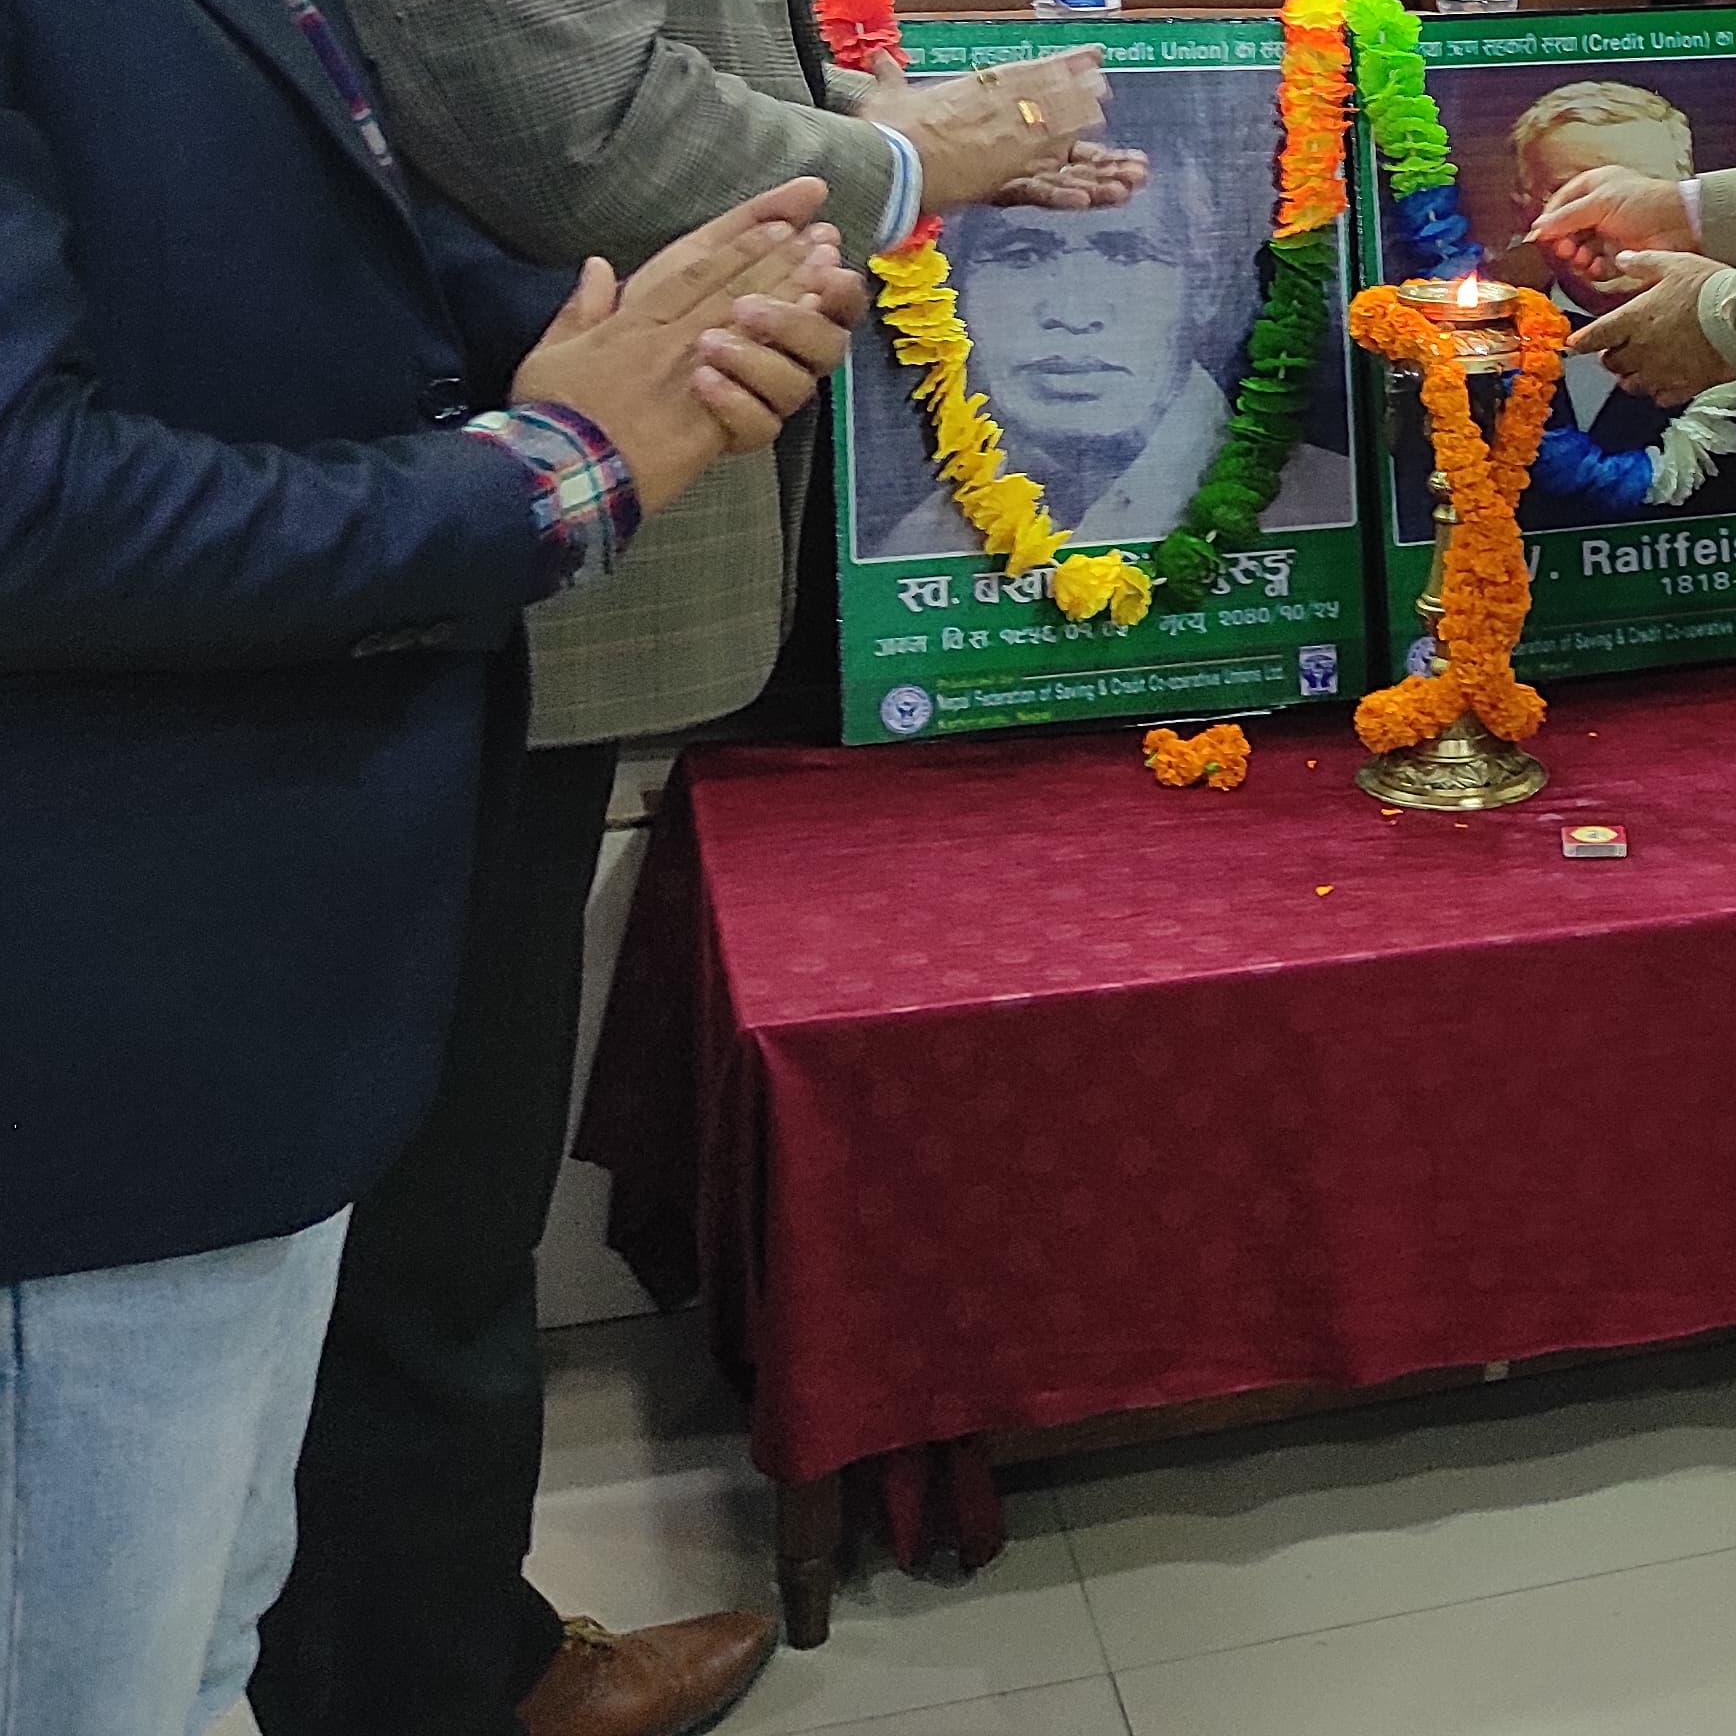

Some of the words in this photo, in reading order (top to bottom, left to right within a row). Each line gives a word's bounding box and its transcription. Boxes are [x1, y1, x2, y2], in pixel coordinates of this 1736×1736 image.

[1160, 39, 1228, 63] Union)
[1581, 31, 1645, 54] (Credit
[1651, 29, 1711, 50] Union)
